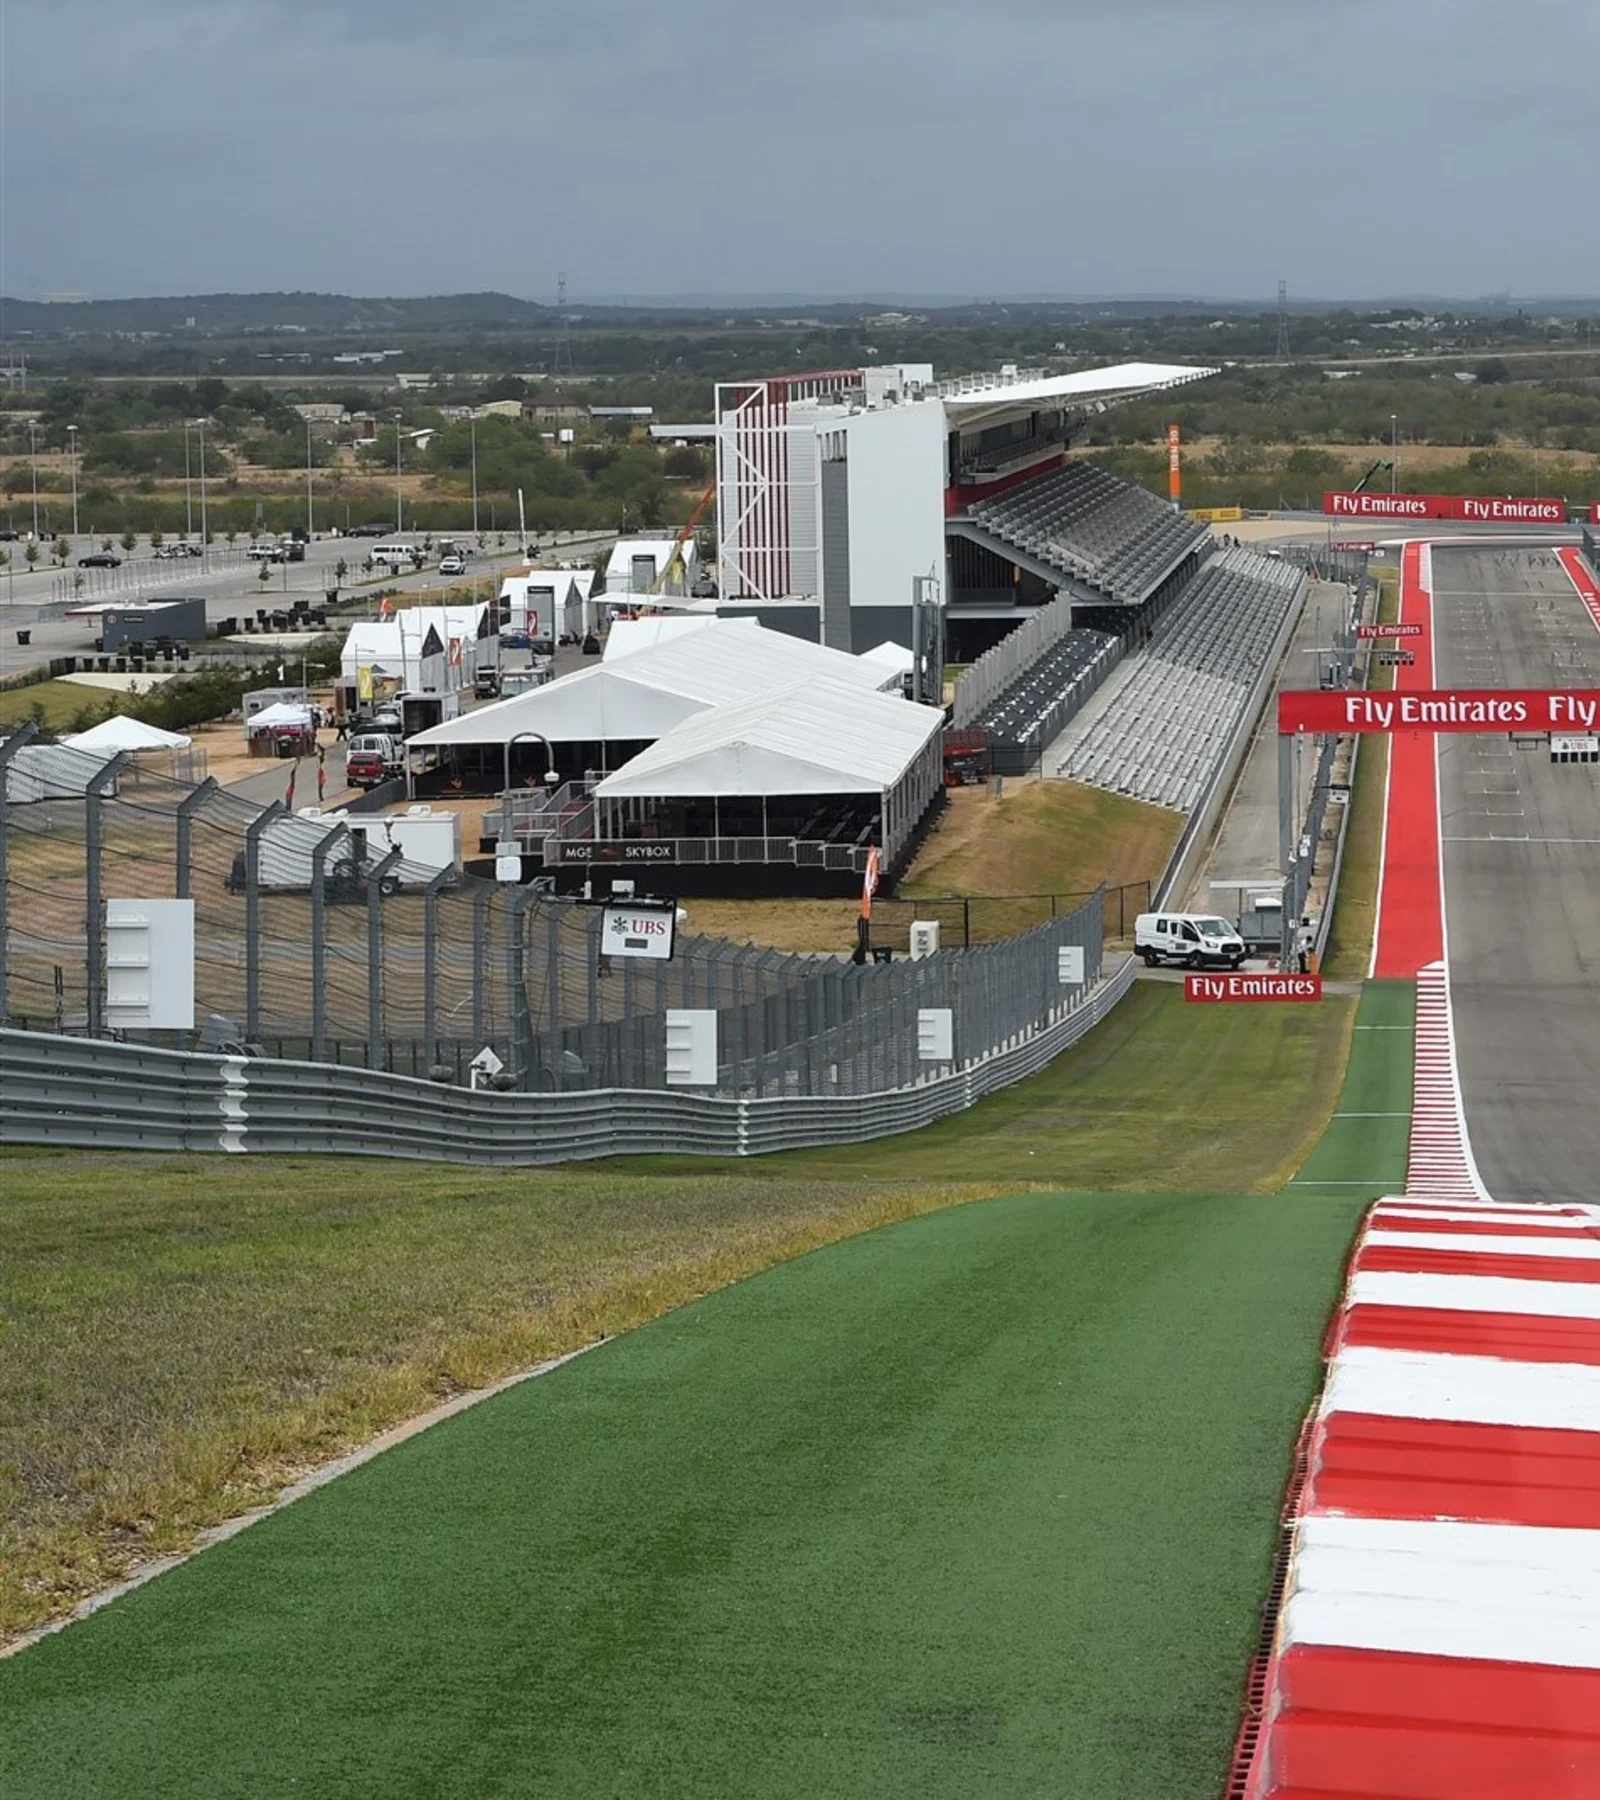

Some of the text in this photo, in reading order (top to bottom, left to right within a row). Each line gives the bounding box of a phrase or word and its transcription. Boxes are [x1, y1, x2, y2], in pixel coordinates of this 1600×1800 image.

[1333, 494, 1427, 514] Fly Emirates
[1464, 500, 1559, 518] Fly Emirates
[1346, 695, 1527, 728] Fly Emirates
[1548, 696, 1597, 726] Fly
[625, 846, 671, 858] SKYBOX
[632, 919, 666, 936] UBS
[1191, 975, 1315, 1000] Fly Emirates
